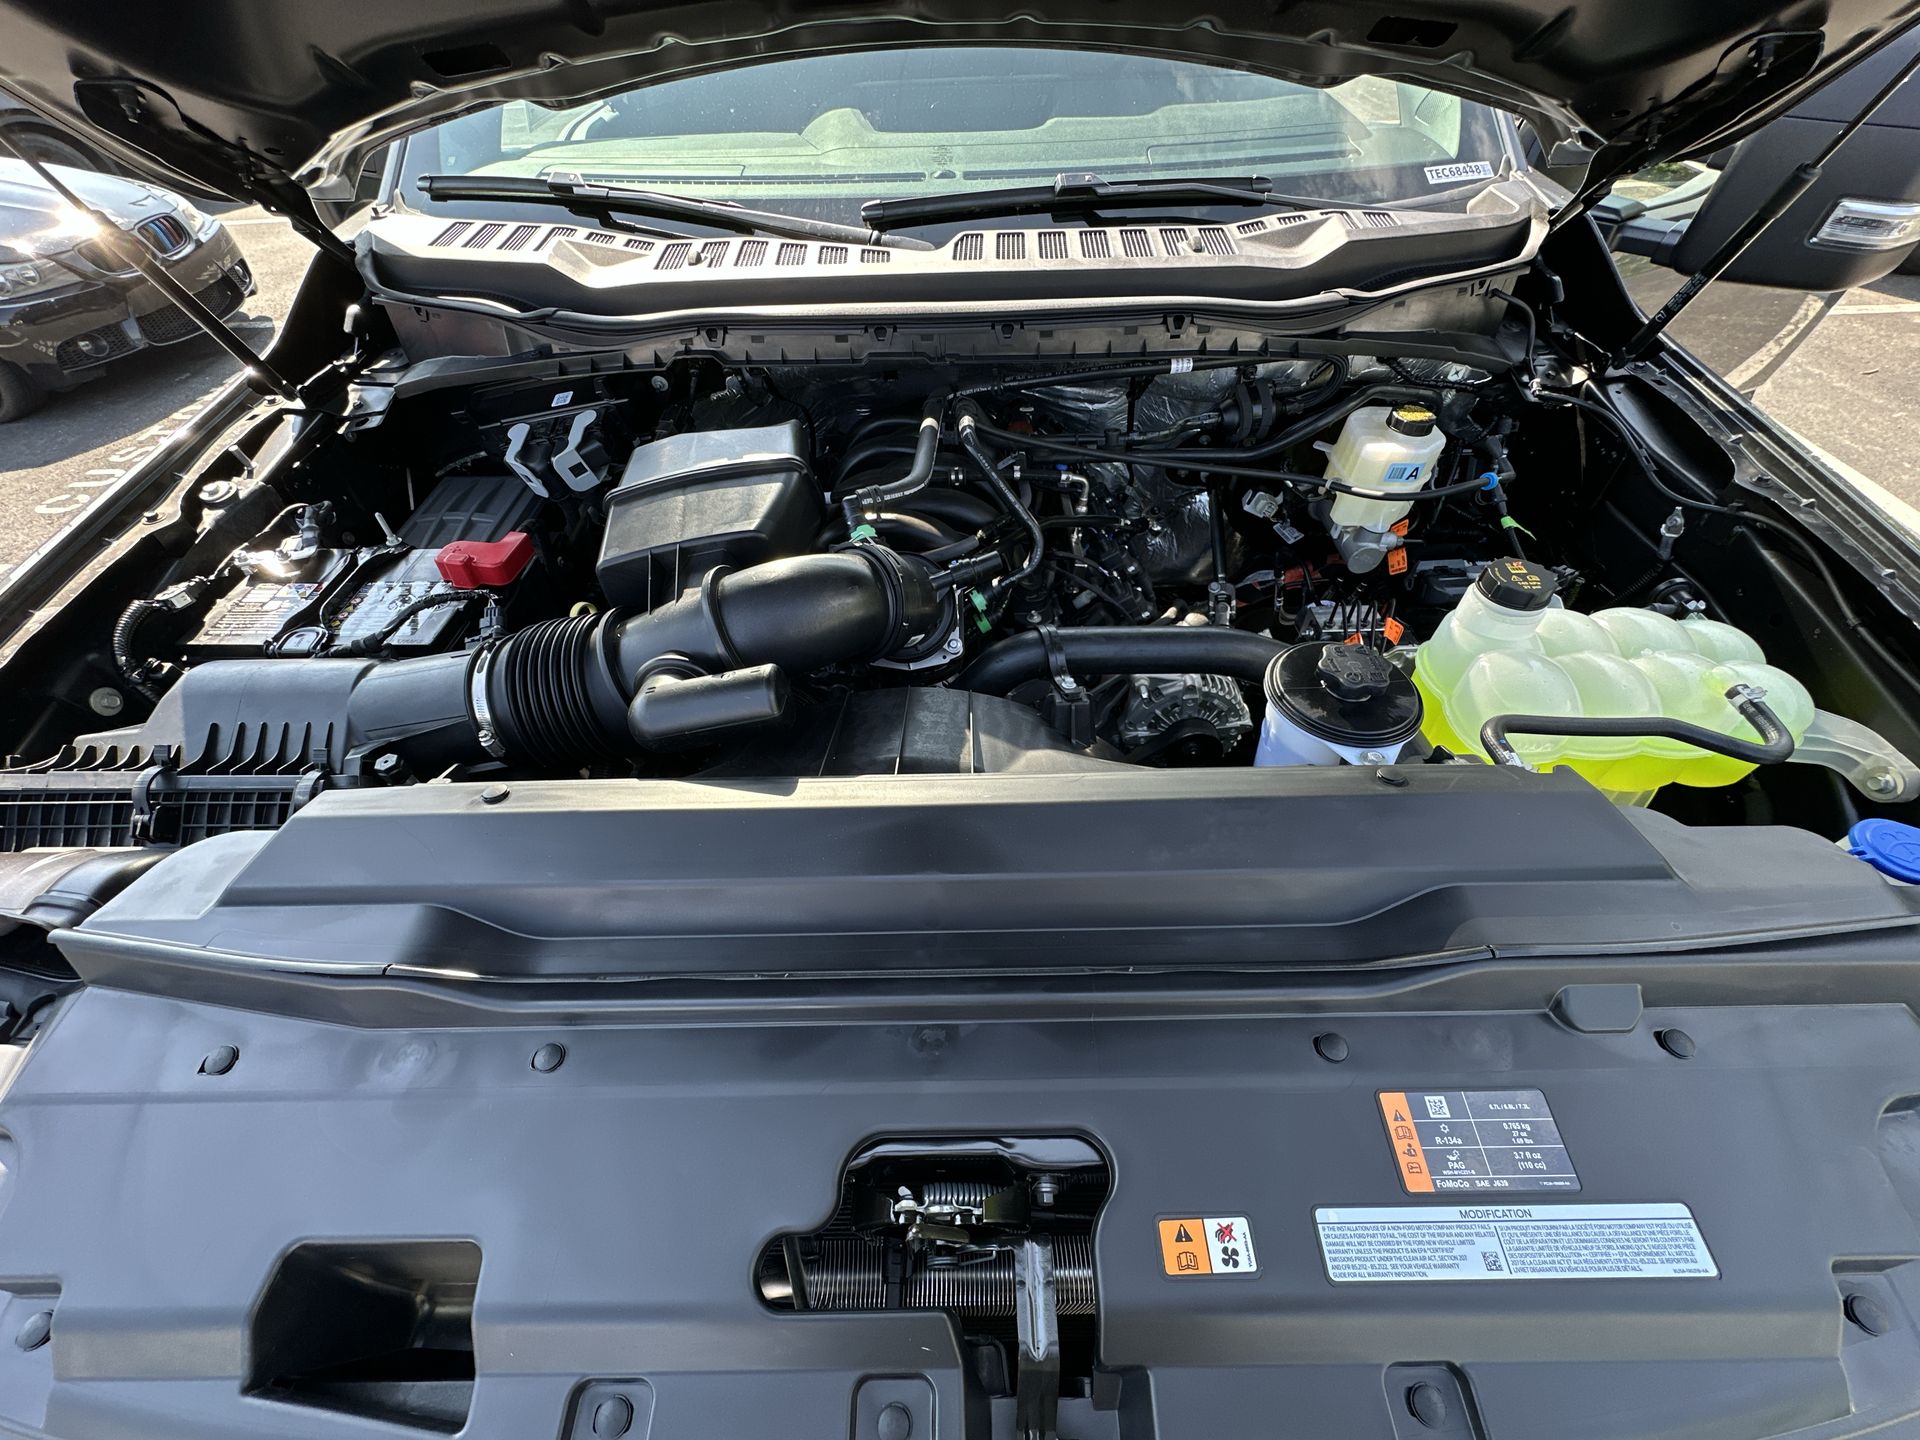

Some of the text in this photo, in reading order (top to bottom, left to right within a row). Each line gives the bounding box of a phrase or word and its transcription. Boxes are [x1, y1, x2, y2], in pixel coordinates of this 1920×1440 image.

[1427, 164, 1482, 180] TEC68448
[1405, 466, 1420, 480] A
[1502, 1122, 1531, 1132] 0.765 kg
[1435, 1136, 1463, 1146] R-134a
[1513, 1151, 1525, 1160] 3.7
[1526, 1151, 1532, 1160] fl
[1448, 1161, 1466, 1170] PAG
[1517, 1161, 1547, 1171] (110 cc)
[1436, 1179, 1509, 1188] FoMoCo SAE J639
[1459, 1208, 1533, 1220] MODIFICATION
